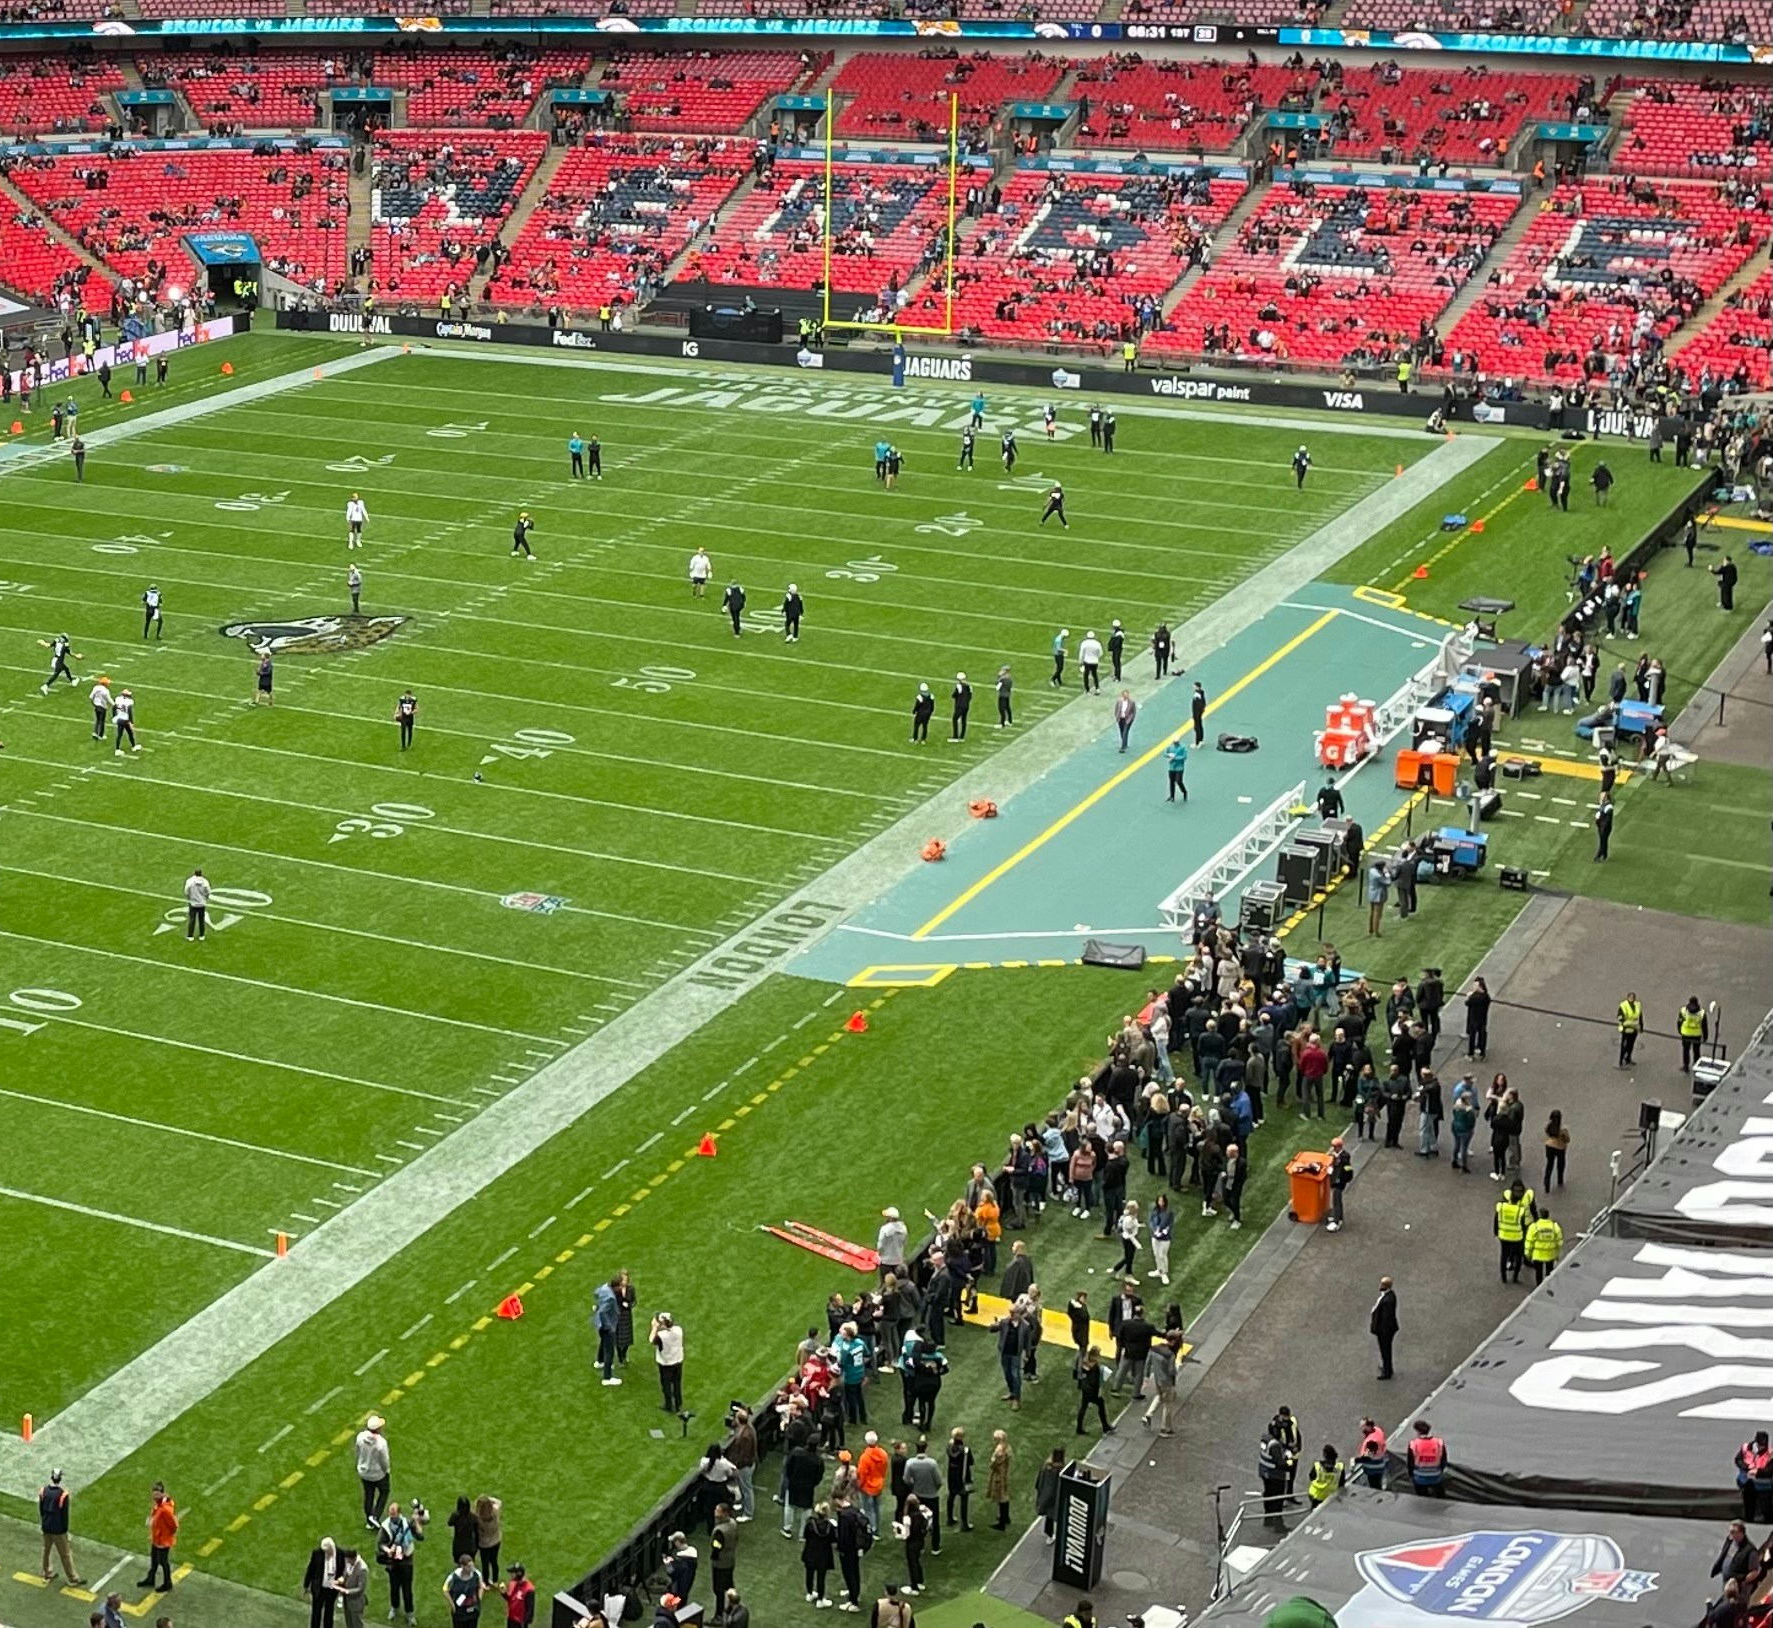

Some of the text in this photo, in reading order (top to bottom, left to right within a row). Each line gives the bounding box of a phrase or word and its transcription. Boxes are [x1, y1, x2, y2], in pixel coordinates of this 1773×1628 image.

[162, 19, 246, 32] BRONCOS
[281, 18, 364, 31] JAGUARS
[668, 18, 756, 32] BRONCOS
[791, 19, 879, 33] JAGUARS
[1459, 33, 1569, 53] BRONCOS
[1613, 39, 1725, 62] JAGUARS
[682, 341, 699, 356] IG
[903, 355, 971, 380] JAGUARS
[1151, 376, 1251, 400] valspar paint
[1323, 391, 1364, 409] VISA
[598, 387, 1088, 441] JAGUARS
[826, 558, 899, 582] 30
[621, 665, 697, 693] 50
[491, 728, 576, 760] 40
[336, 801, 436, 840] 30
[686, 899, 847, 991] LONDON
[1065, 1494, 1089, 1574] DUUUVAL!
[1445, 1554, 1486, 1591] GAMES
[1447, 1536, 1543, 1614] LONDON
